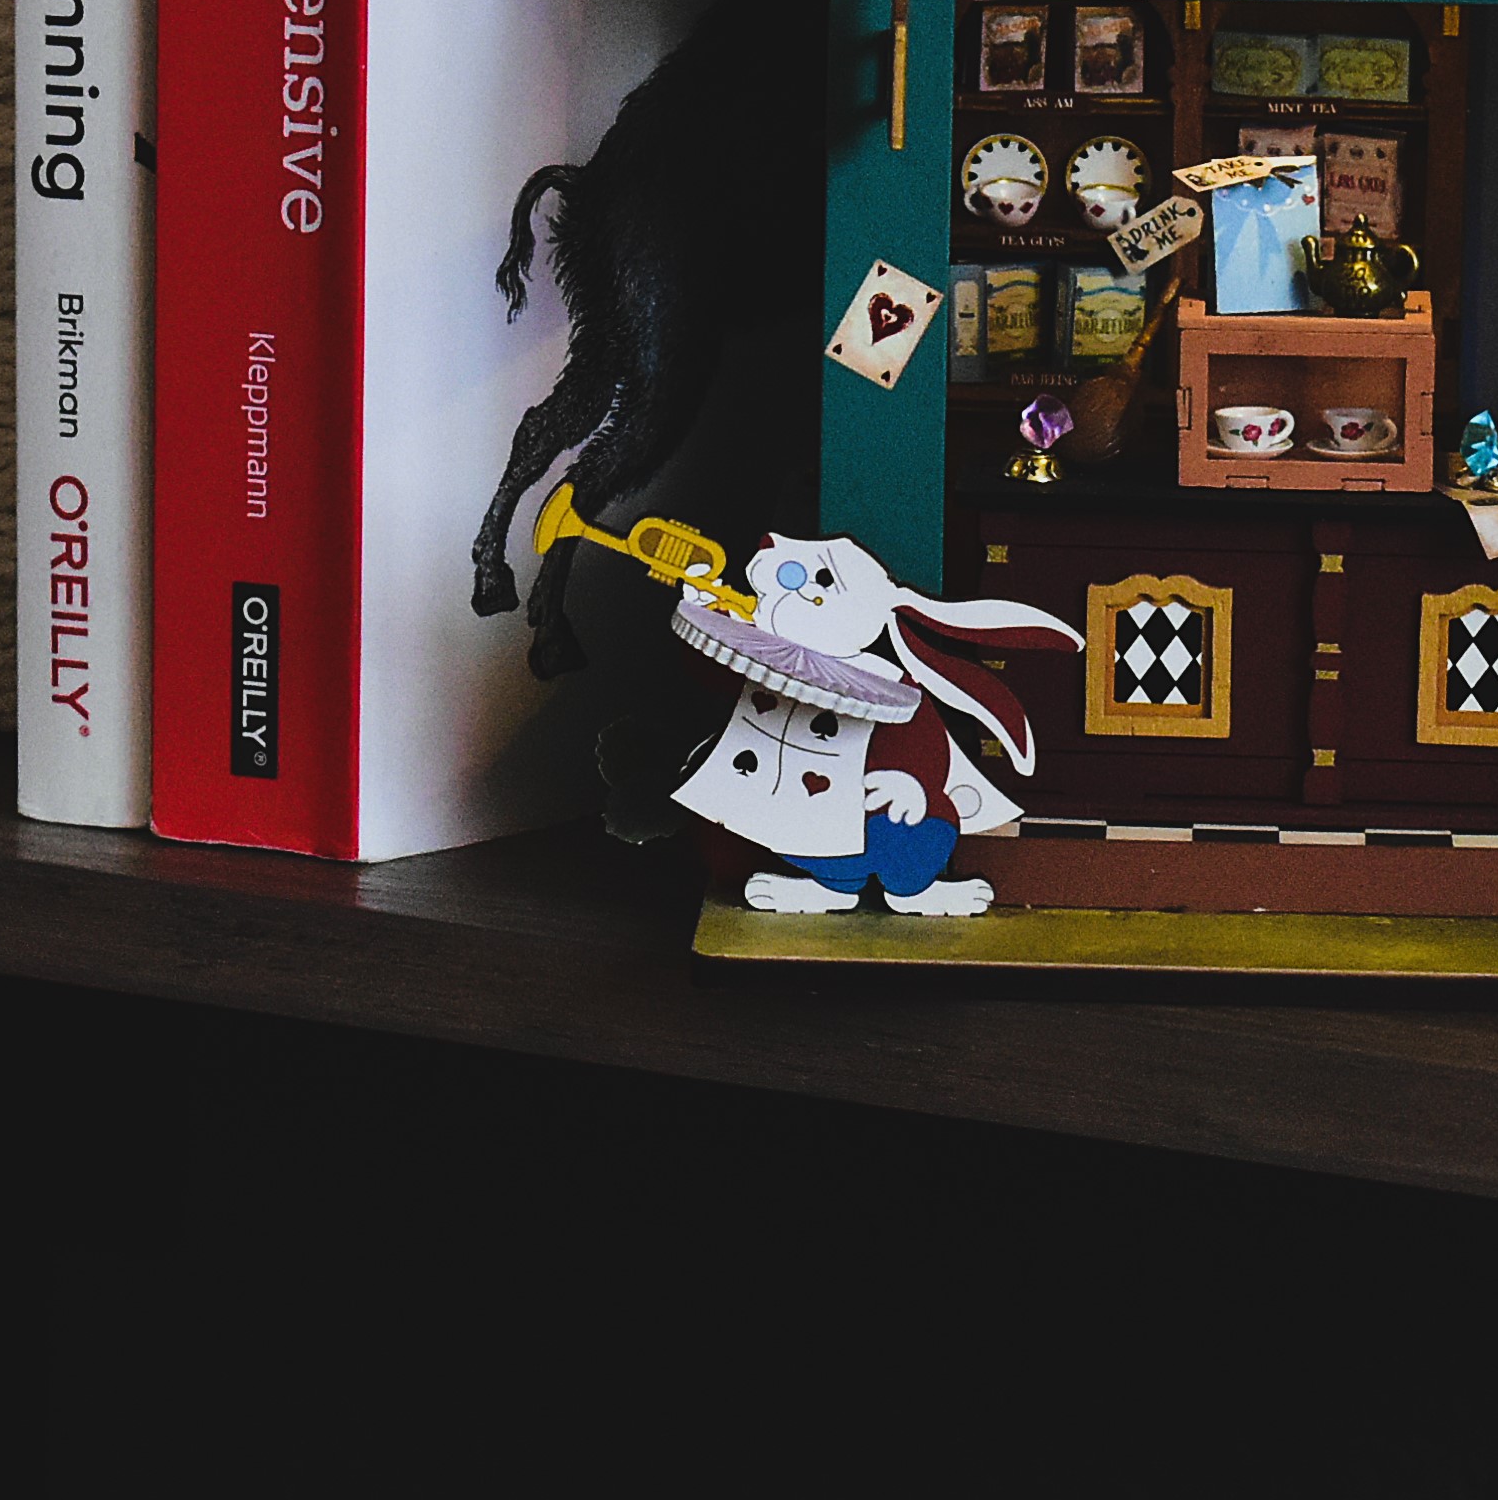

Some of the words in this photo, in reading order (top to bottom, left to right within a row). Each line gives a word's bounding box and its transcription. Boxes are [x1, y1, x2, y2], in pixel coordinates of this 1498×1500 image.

[1267, 102, 1304, 114] MINT
[1310, 102, 1337, 114] TEA
[1128, 202, 1185, 244] DRINK
[1150, 225, 1183, 250] ME
[57, 293, 84, 438] Brikman
[241, 332, 275, 518] Kleppmann
